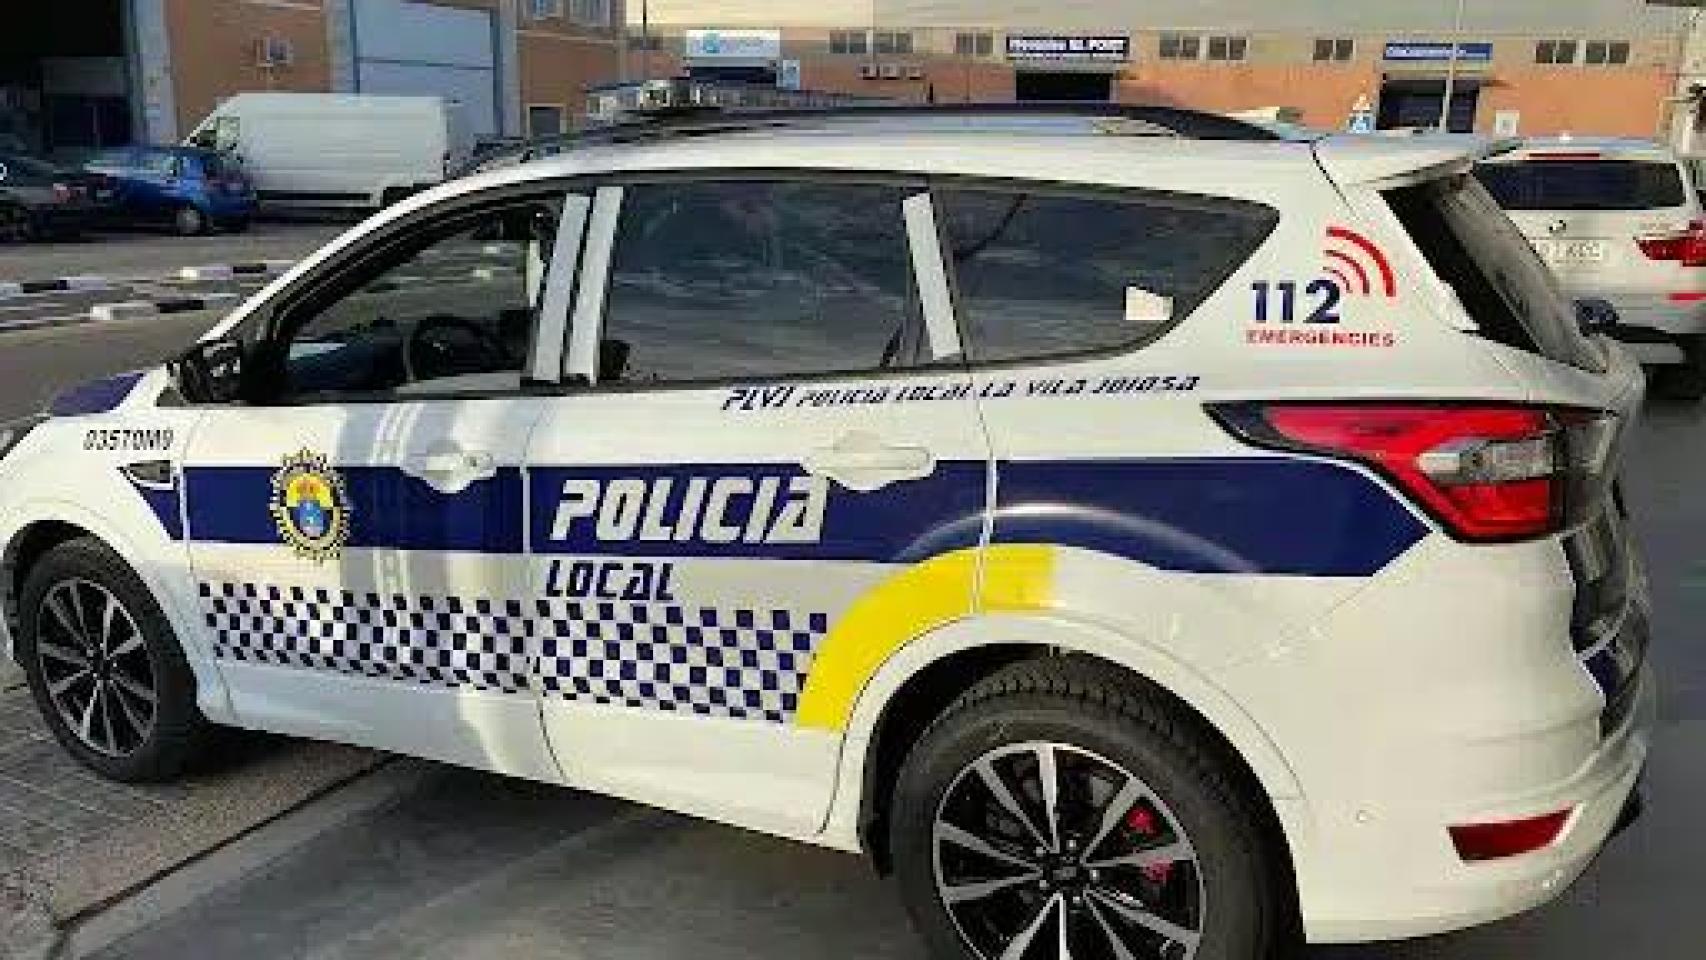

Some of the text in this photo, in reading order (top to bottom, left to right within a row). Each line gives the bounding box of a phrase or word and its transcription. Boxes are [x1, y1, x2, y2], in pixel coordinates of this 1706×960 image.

[1250, 279, 1341, 324] 112
[1245, 329, 1394, 347] EMERGENCIES
[796, 388, 890, 408] POLICIA
[895, 384, 975, 402] LOCAL
[1026, 379, 1087, 397] VILA
[549, 475, 828, 544] POLICIA
[545, 558, 675, 601] LOCAL
